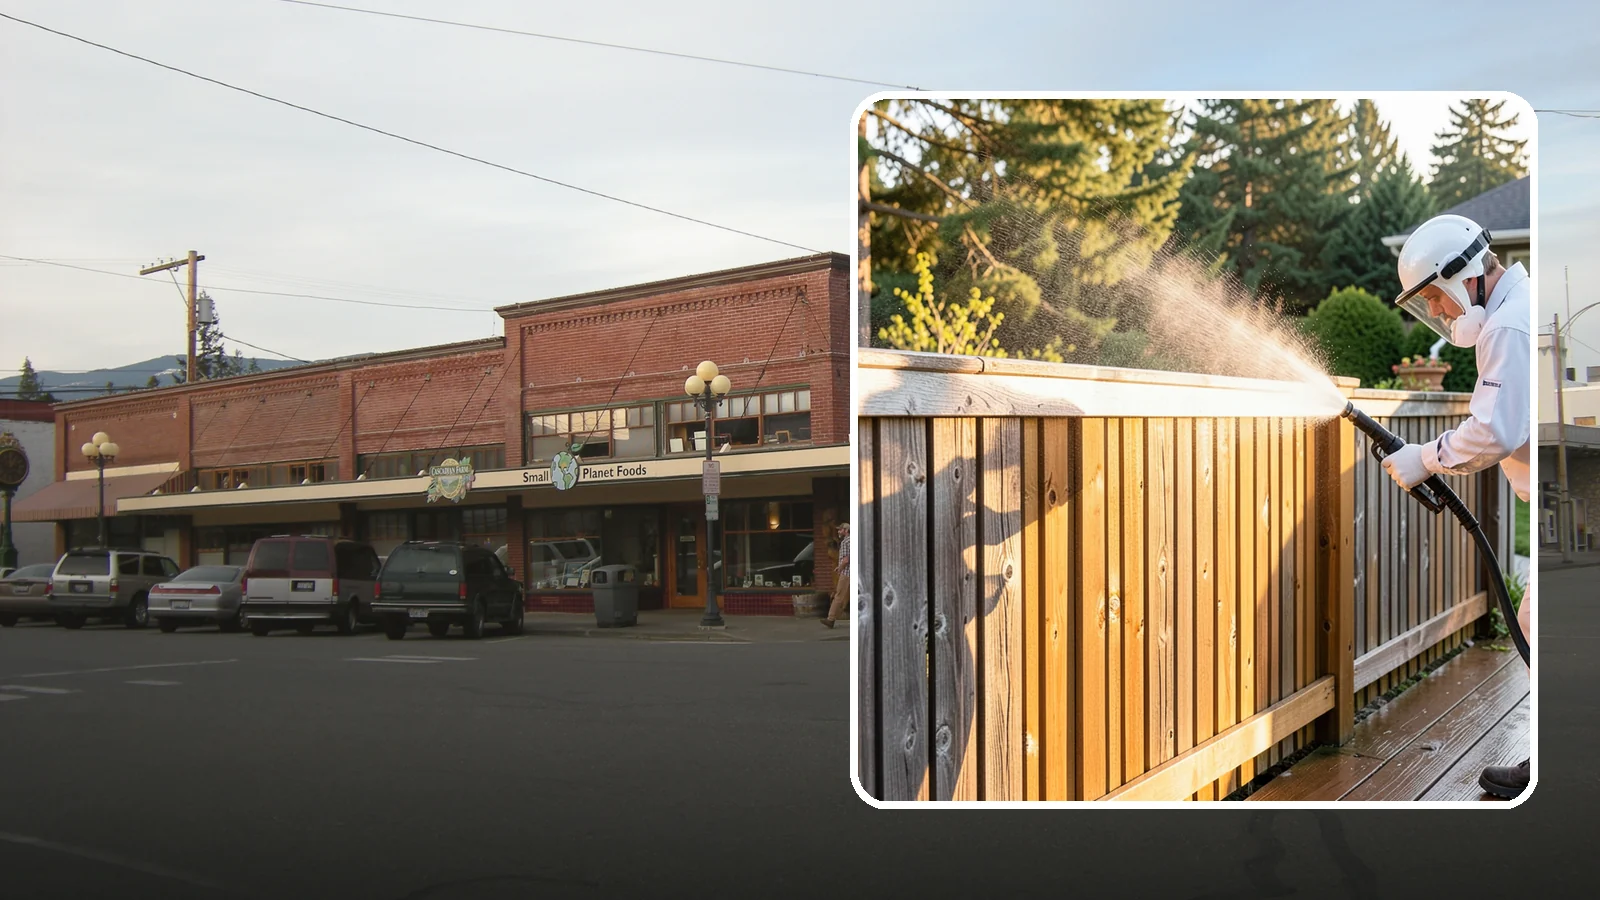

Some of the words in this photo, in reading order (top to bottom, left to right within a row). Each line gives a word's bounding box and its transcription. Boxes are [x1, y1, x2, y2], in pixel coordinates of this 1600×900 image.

[523, 471, 549, 482] Small
[583, 466, 614, 479] Planet
[616, 464, 647, 477] Foods
